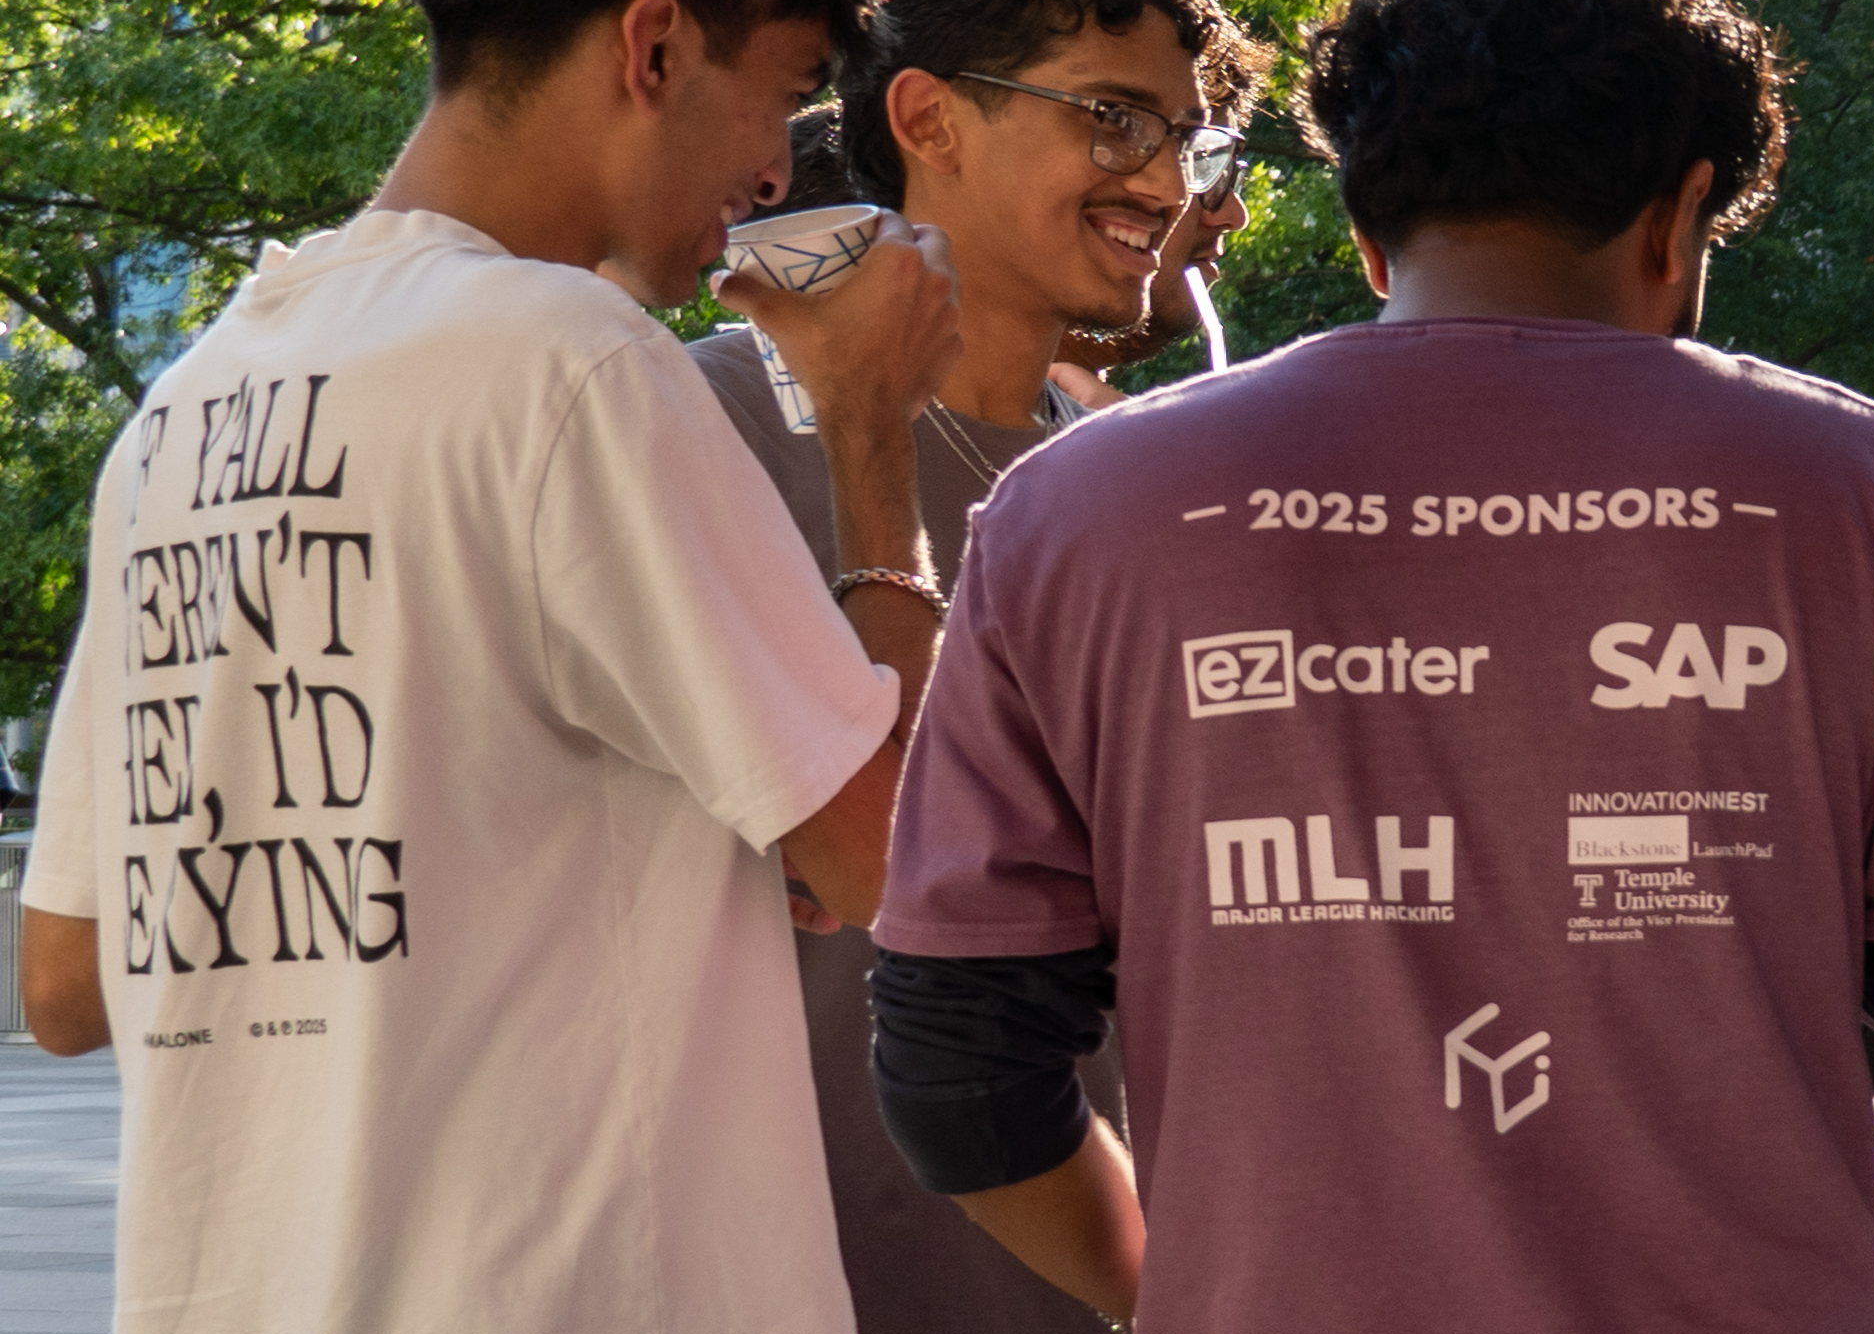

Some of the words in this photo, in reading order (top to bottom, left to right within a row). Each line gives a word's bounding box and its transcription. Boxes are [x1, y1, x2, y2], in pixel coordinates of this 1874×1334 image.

[191, 373, 348, 511] Y'ALL
[1248, 488, 1389, 535] 2025
[1411, 487, 1720, 536] SPONSORS
[124, 510, 372, 673] EREN'T
[1196, 636, 1490, 702] ezcater
[1588, 622, 1789, 710] SAP
[254, 666, 374, 808] I'D
[1568, 790, 1770, 813] INNOVATIONNEST
[1204, 814, 1455, 907] MLH
[1575, 840, 1682, 858] Blackstone
[1692, 841, 1775, 859] LaunchPad
[164, 837, 409, 970] YING
[1614, 867, 1696, 891] Temple
[1614, 890, 1730, 914] University
[1211, 907, 1284, 926] MAJOR
[1289, 903, 1366, 922] LEAGUE
[1369, 905, 1455, 922] HACKING
[1567, 916, 1605, 929] Office
[1606, 915, 1622, 928] of
[1623, 916, 1645, 928] the
[1646, 914, 1674, 927] Vice
[1675, 914, 1735, 926] President
[1567, 930, 1587, 942] for
[1588, 929, 1645, 941] Research
